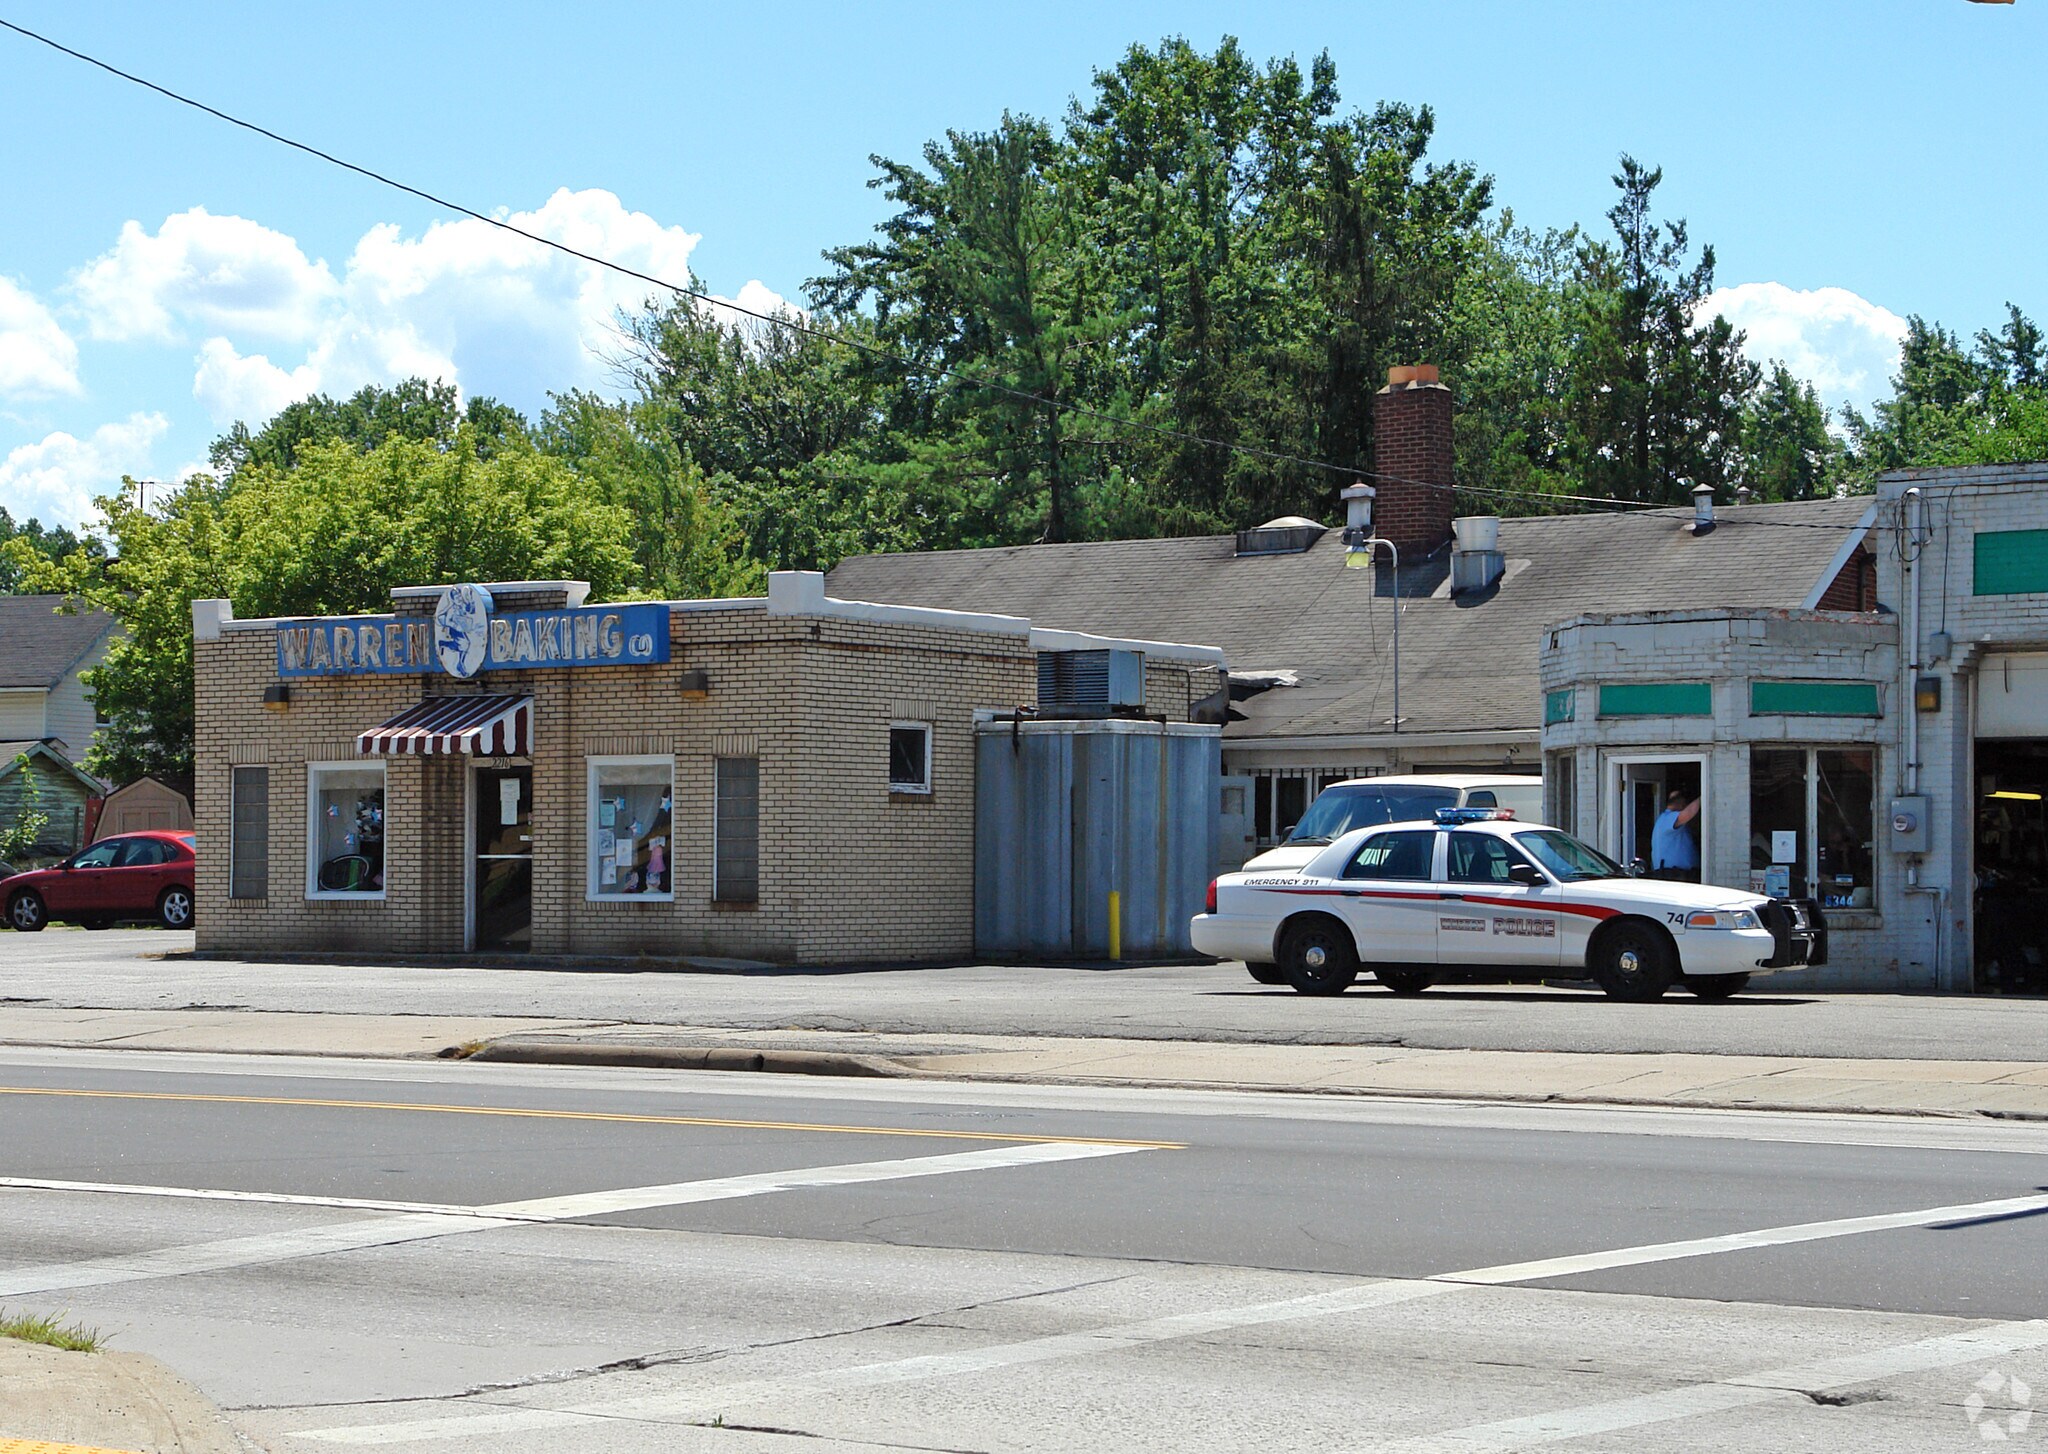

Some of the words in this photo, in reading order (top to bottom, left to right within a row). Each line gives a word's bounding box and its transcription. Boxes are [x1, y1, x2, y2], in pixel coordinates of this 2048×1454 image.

[278, 623, 430, 670] WARREN
[490, 614, 624, 663] BAKING
[1244, 878, 1300, 886] EMERGENCY
[1667, 911, 1684, 925] 74
[1493, 917, 1555, 937] POLICE
